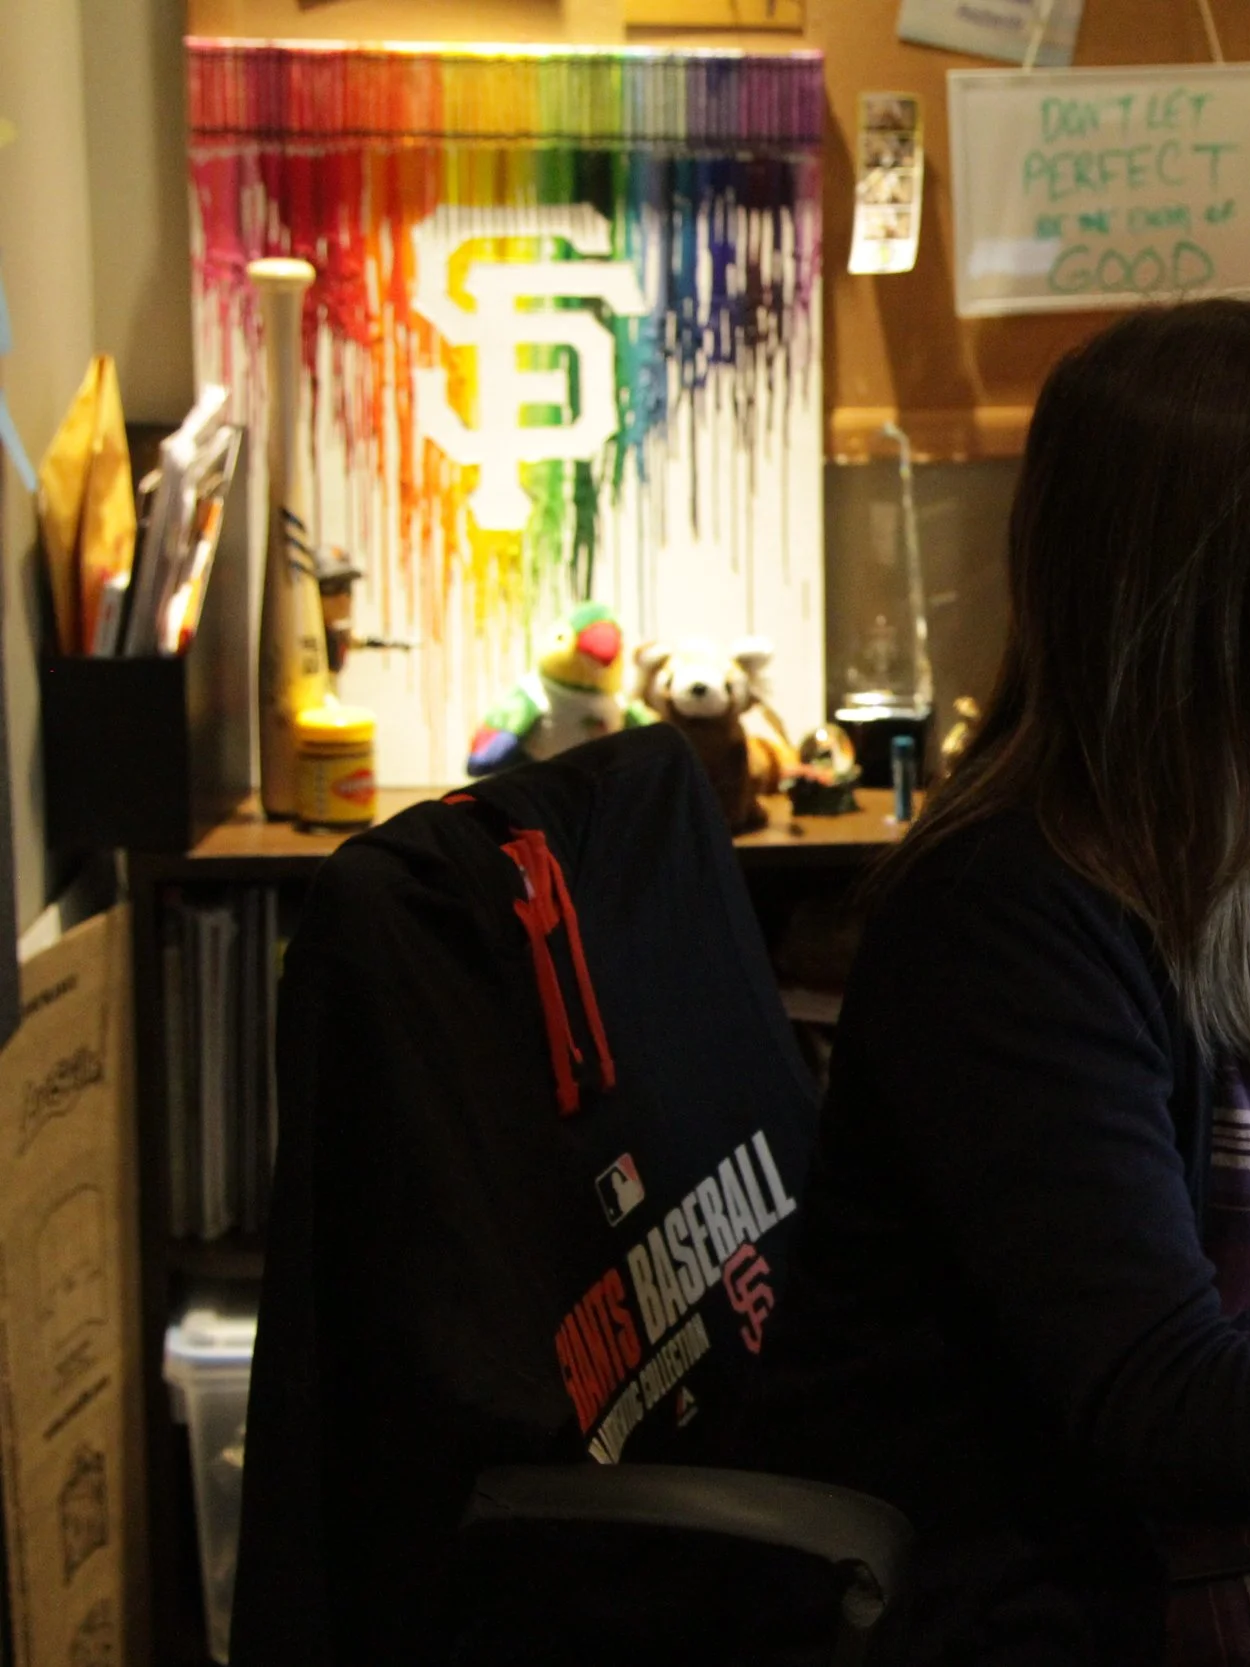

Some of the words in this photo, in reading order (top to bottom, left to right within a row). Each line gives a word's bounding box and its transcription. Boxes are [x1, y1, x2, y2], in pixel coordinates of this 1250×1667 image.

[1147, 88, 1211, 130] LET
[1024, 139, 1239, 200] PERFECT
[1049, 240, 1214, 294] GOOD
[410, 201, 647, 532] SF
[555, 1267, 642, 1437] GIANTS
[627, 1130, 797, 1345] BASEBALL
